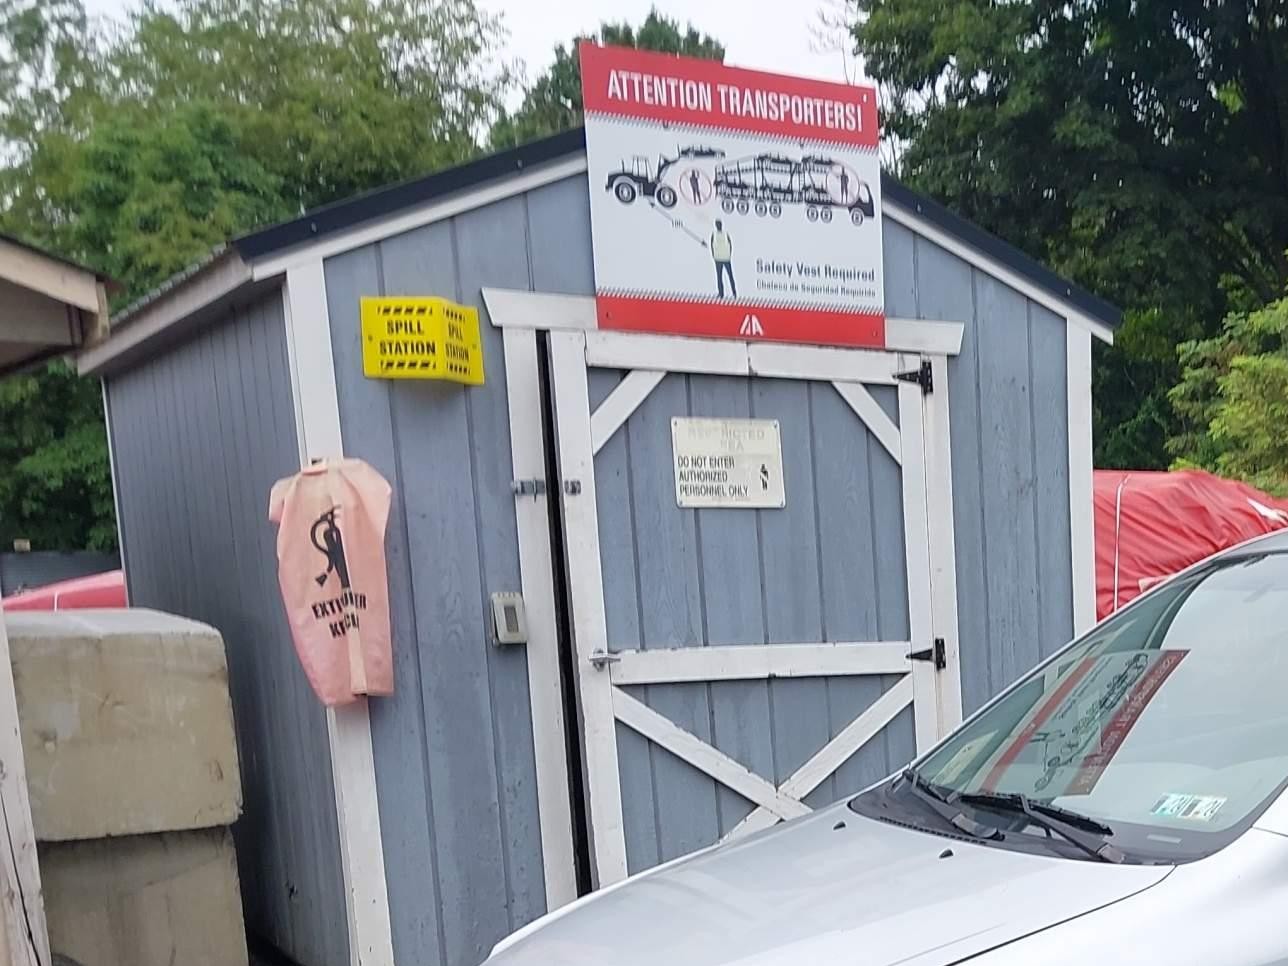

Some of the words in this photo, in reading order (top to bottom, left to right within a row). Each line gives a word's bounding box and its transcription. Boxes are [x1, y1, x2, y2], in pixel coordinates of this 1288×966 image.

[607, 69, 712, 112] ATTENTION
[717, 83, 863, 132] TRANSPORTERS!
[756, 259, 793, 277] Safety
[796, 262, 821, 277] Vest
[824, 264, 875, 282] Required
[387, 320, 424, 335] SPILL
[380, 341, 436, 356] STATION
[445, 343, 470, 363] STATION
[678, 456, 690, 468] DO
[691, 456, 707, 468] NOT
[709, 456, 735, 469] ENTER
[679, 470, 728, 482] AUTHORIZED
[680, 484, 726, 497] PERSONNEL
[728, 485, 748, 497] ONLY
